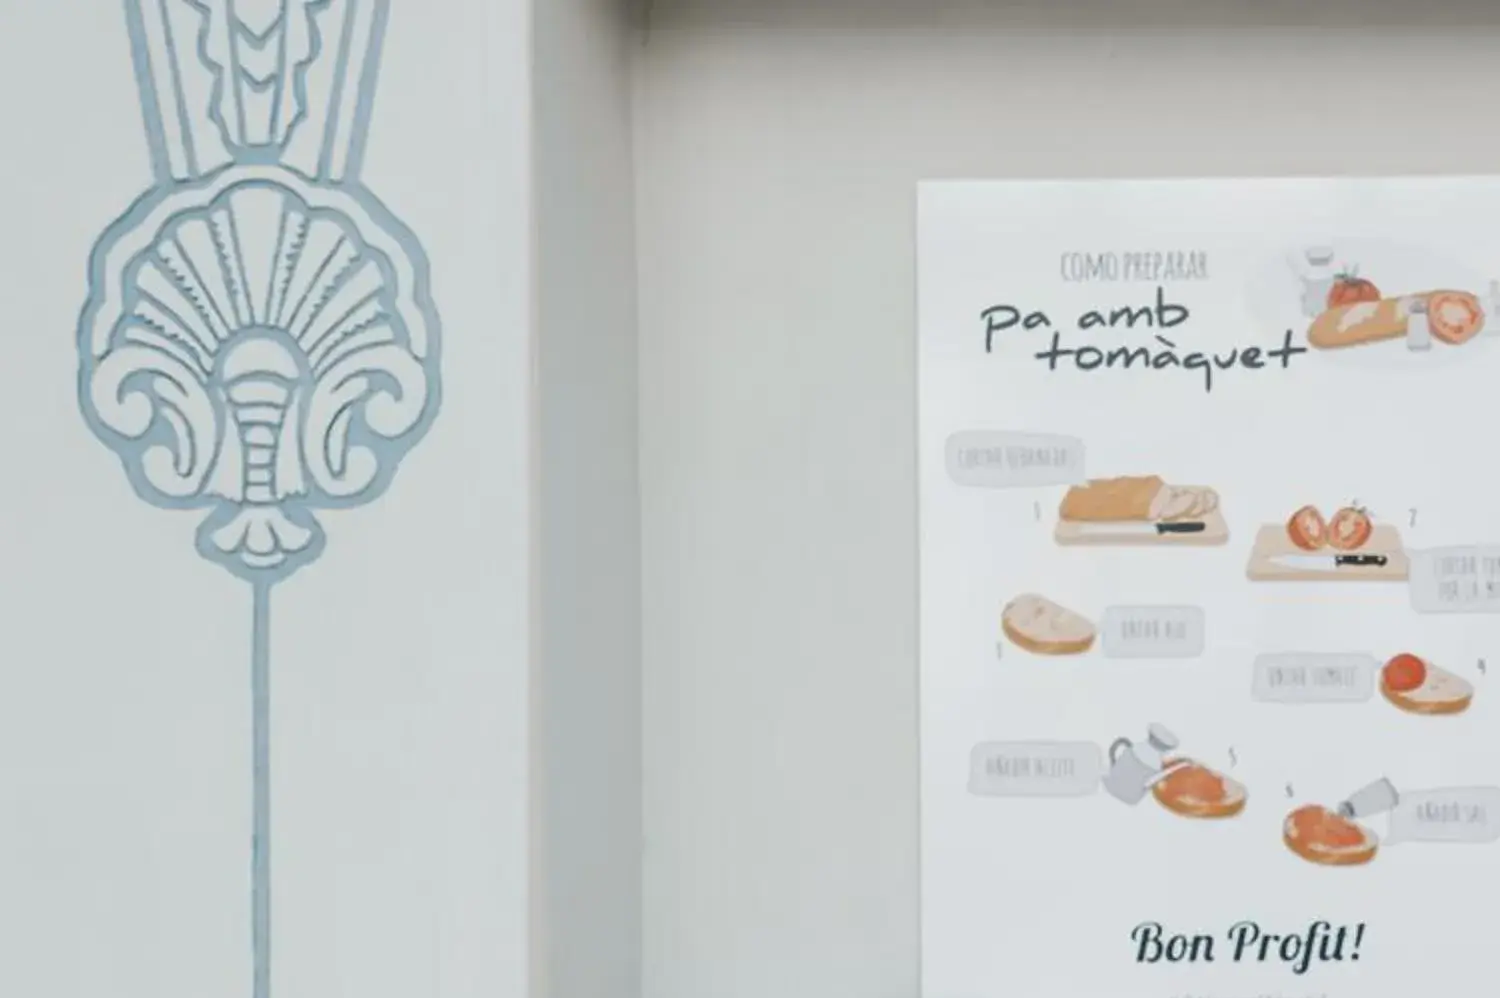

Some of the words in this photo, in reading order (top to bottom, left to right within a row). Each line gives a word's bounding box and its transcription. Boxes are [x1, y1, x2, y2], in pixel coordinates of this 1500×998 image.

[1060, 251, 1118, 282] COMO
[1122, 250, 1208, 281] PREPARAR
[980, 304, 1051, 353] pa
[1078, 285, 1190, 329] amb
[1034, 329, 1308, 393] tomàquet
[1131, 920, 1215, 963] Bon
[1227, 920, 1366, 975] Profit!
